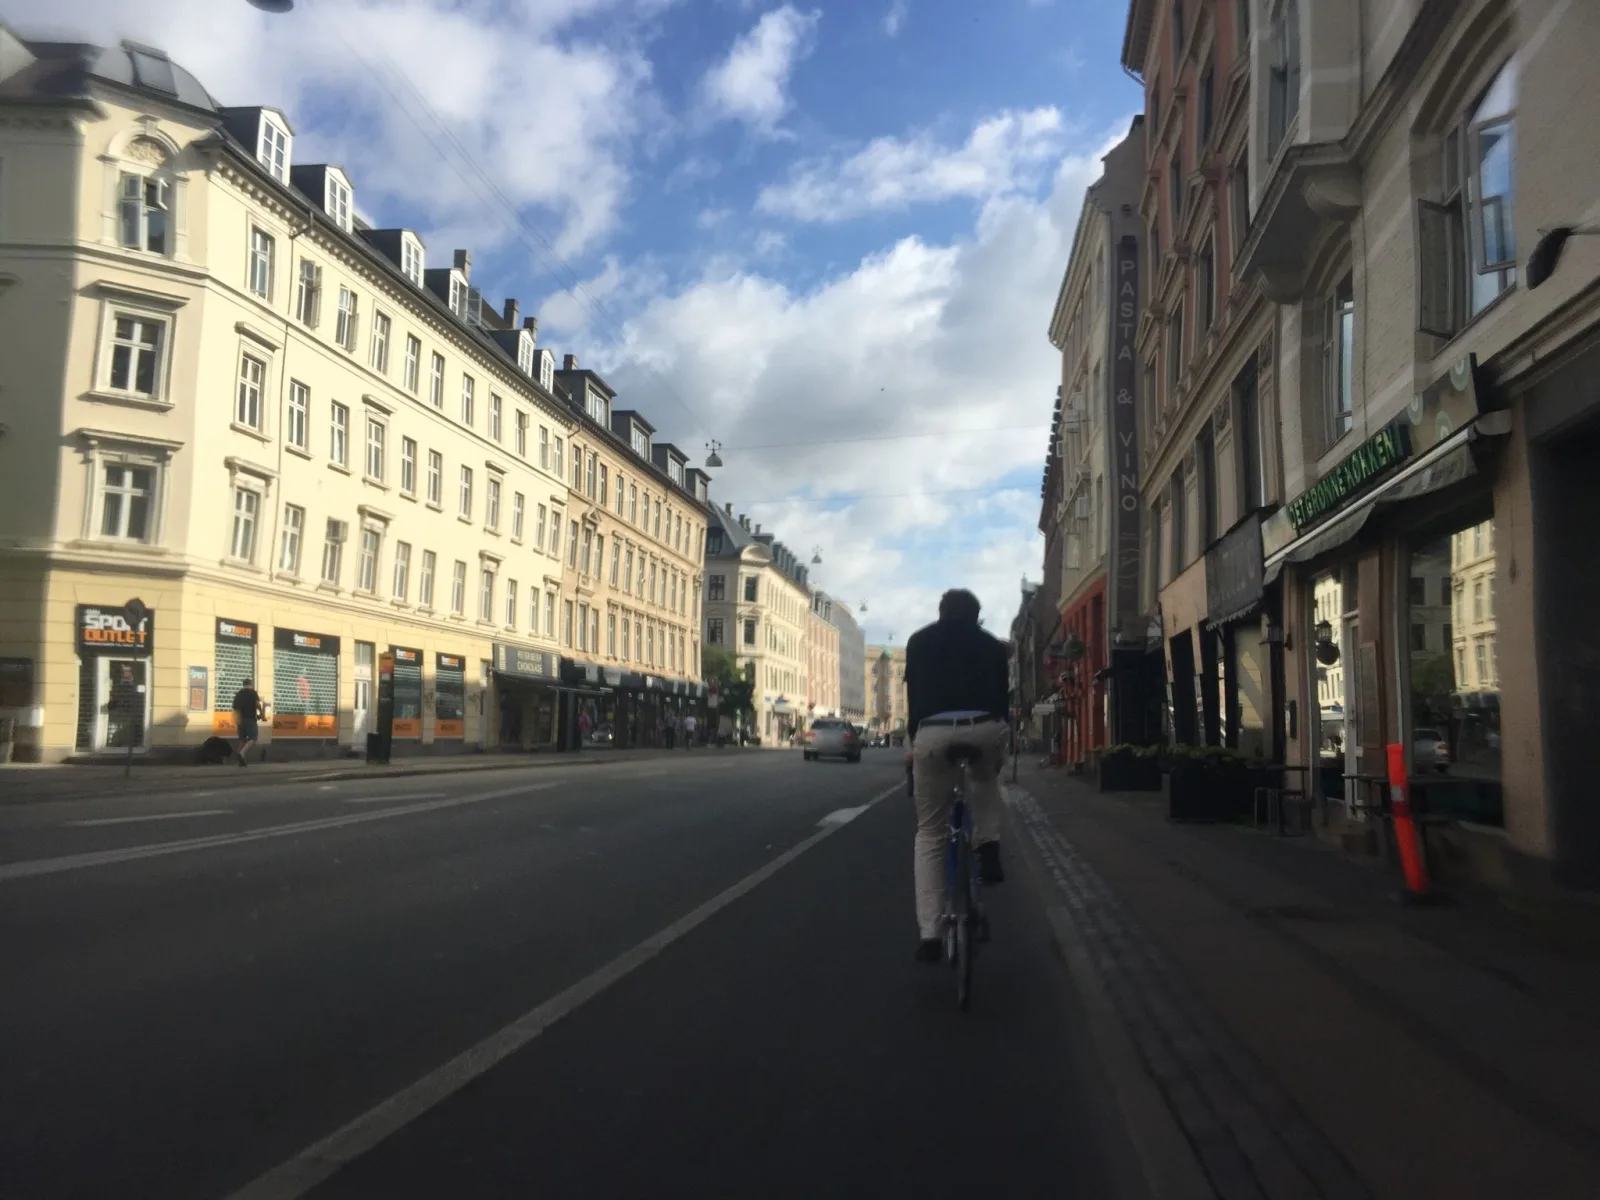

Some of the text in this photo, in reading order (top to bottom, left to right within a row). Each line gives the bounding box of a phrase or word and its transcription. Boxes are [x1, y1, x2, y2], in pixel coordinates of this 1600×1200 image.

[1117, 260, 1137, 512] PASTA & VINO
[84, 614, 148, 632] SPOT
[84, 629, 148, 643] OUTLET
